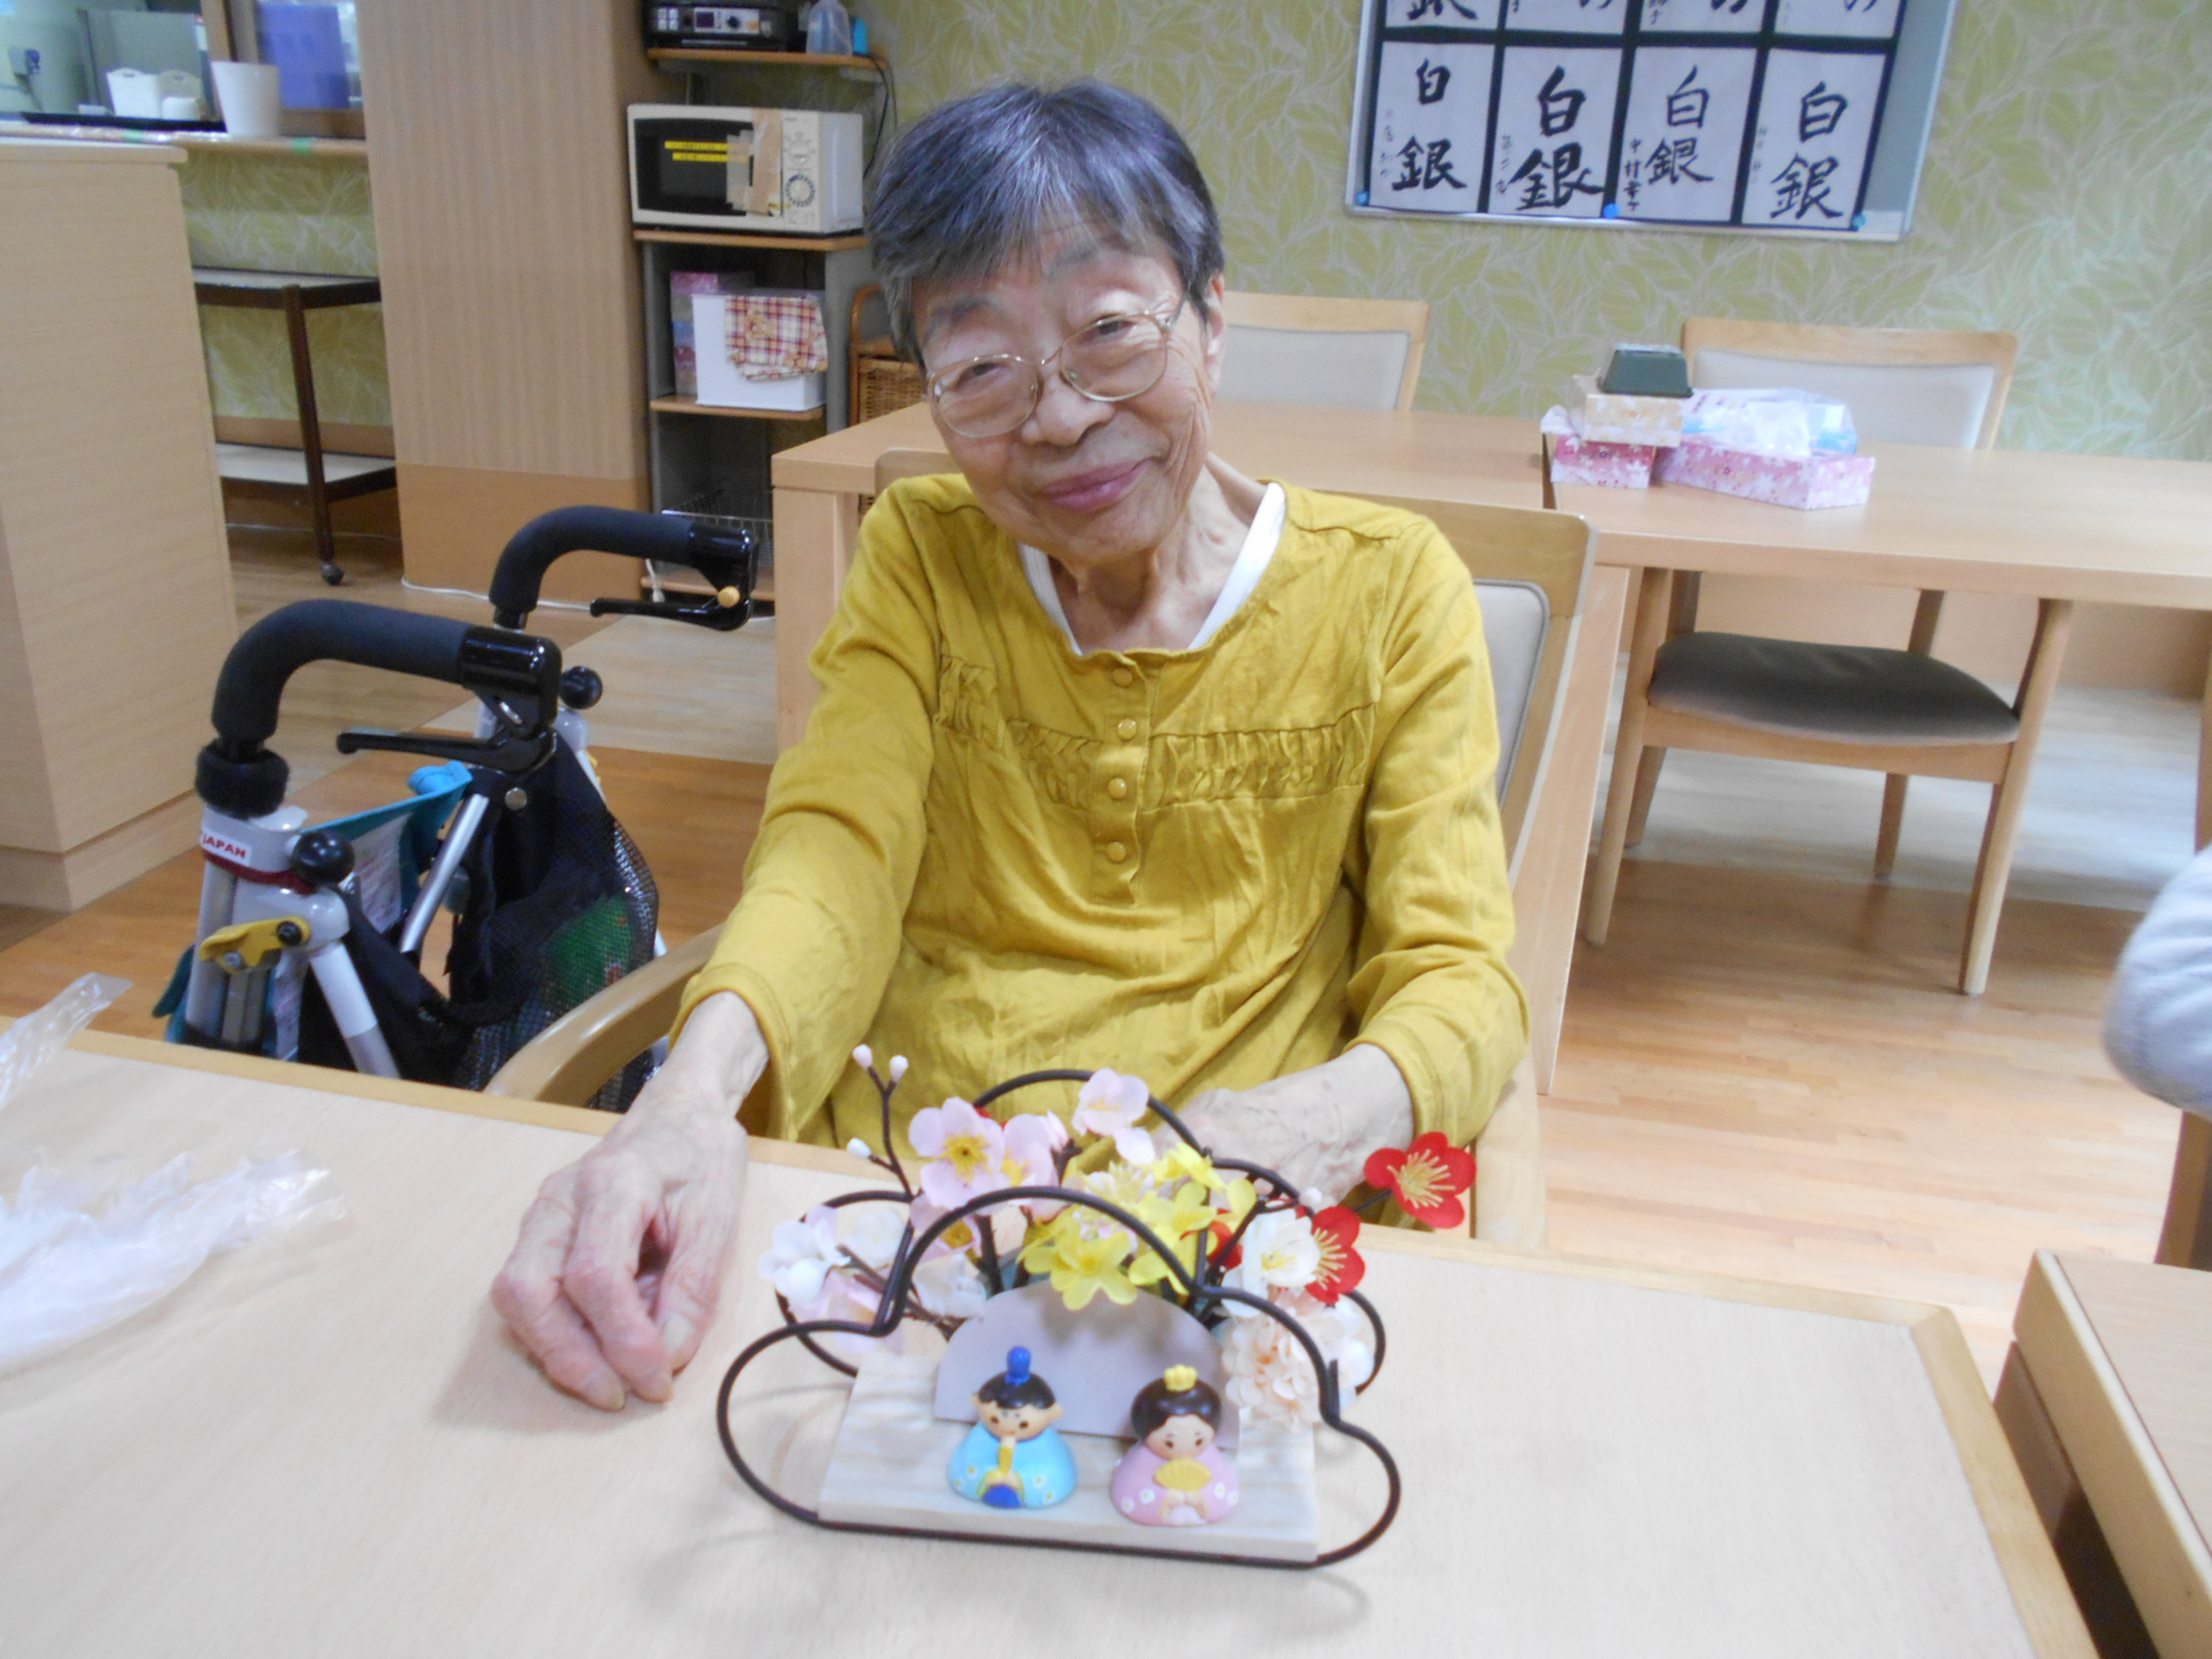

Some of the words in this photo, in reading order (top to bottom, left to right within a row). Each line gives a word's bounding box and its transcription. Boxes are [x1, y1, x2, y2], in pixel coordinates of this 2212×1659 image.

[1392, 57, 1467, 190] 白銀
[1510, 65, 1605, 209] 白銀
[1644, 64, 1714, 184] 白銀
[1770, 80, 1846, 219] 白銀
[202, 833, 246, 858] JAPAN
